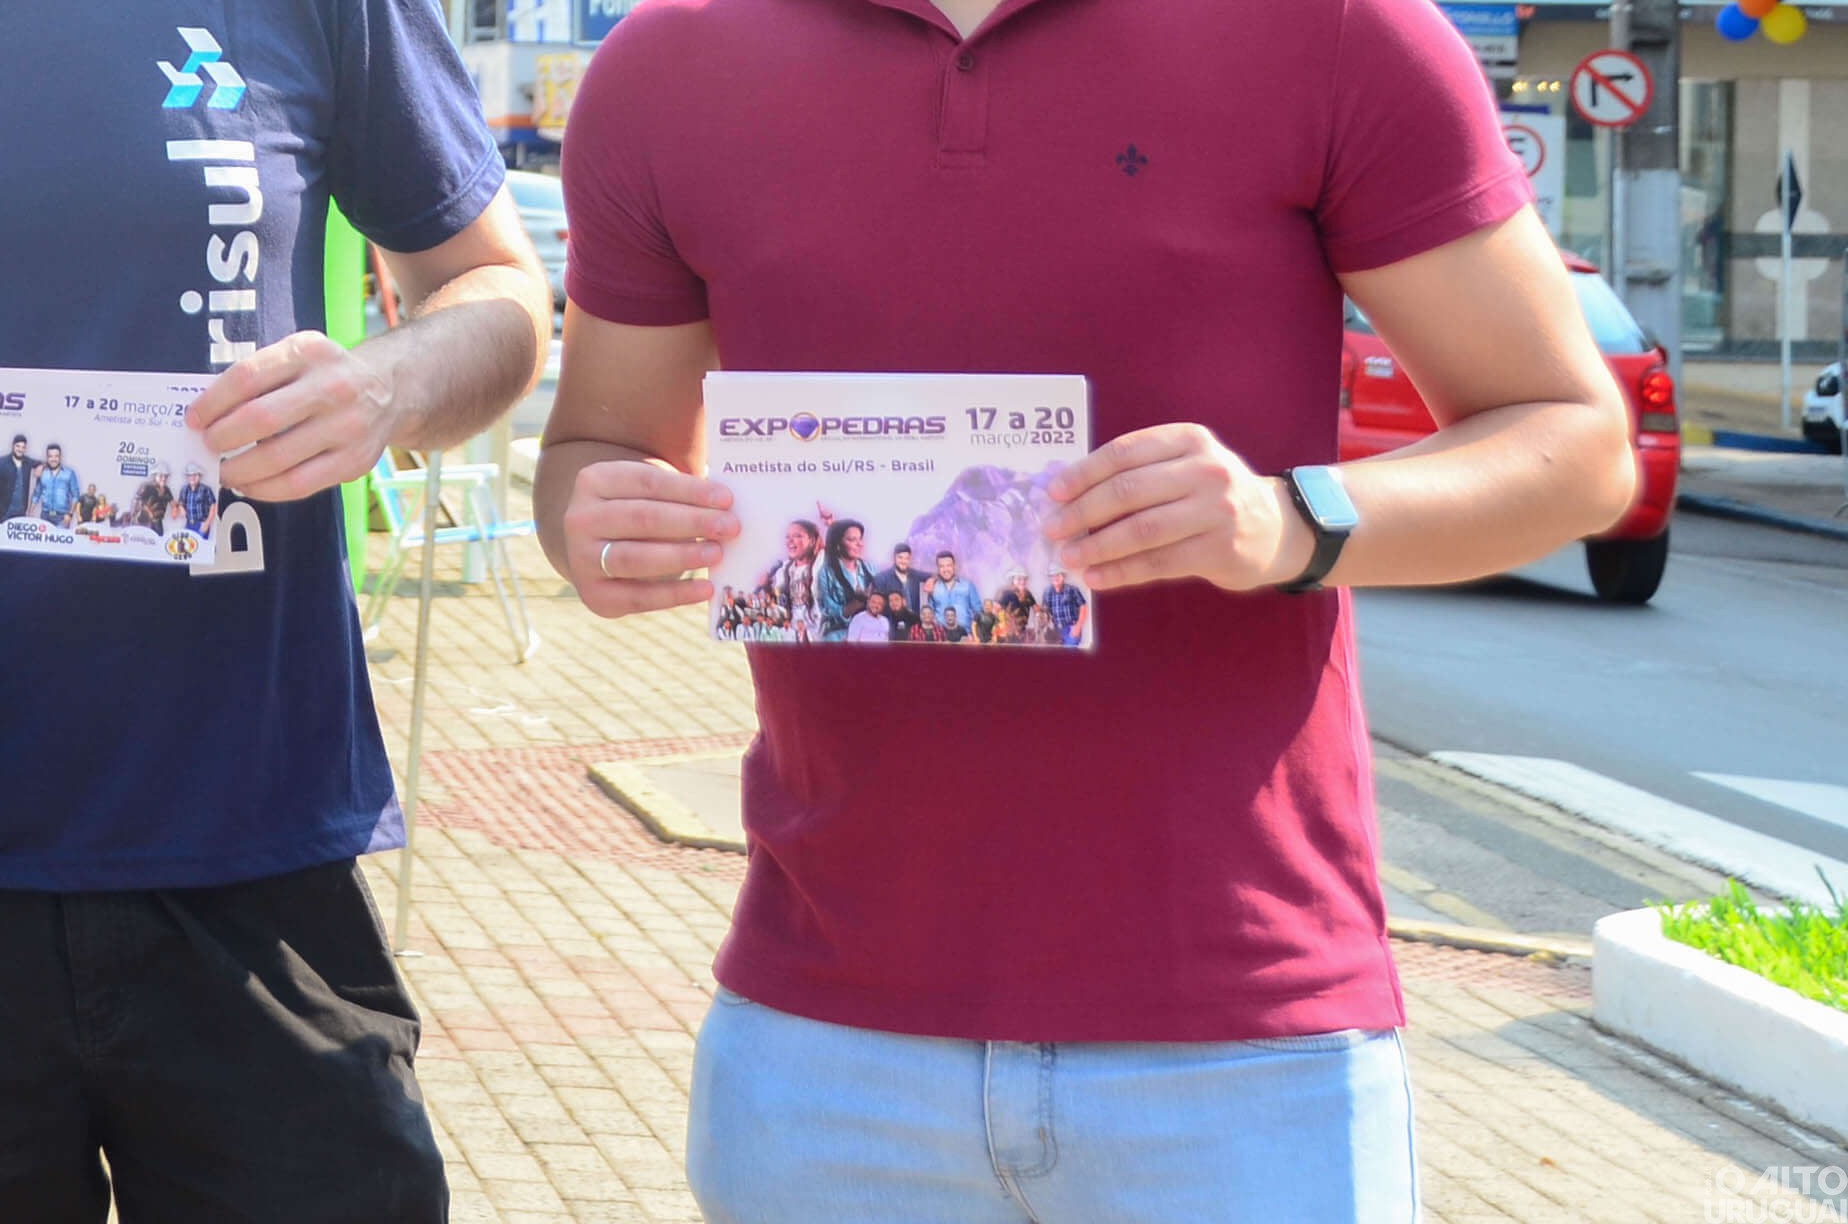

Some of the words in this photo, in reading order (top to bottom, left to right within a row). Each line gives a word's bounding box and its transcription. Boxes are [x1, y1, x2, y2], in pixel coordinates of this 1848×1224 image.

[65, 395, 80, 409] 17
[86, 400, 95, 409] a
[100, 398, 118, 411] 20
[965, 407, 997, 430] 17
[1009, 412, 1026, 430] a
[1035, 407, 1074, 430] 20
[118, 441, 135, 454] 20
[970, 431, 1075, 448] março/2022
[723, 460, 792, 474] Ametista
[797, 460, 817, 473] do
[822, 459, 875, 473] Sul/RS
[891, 459, 935, 473] Brasil
